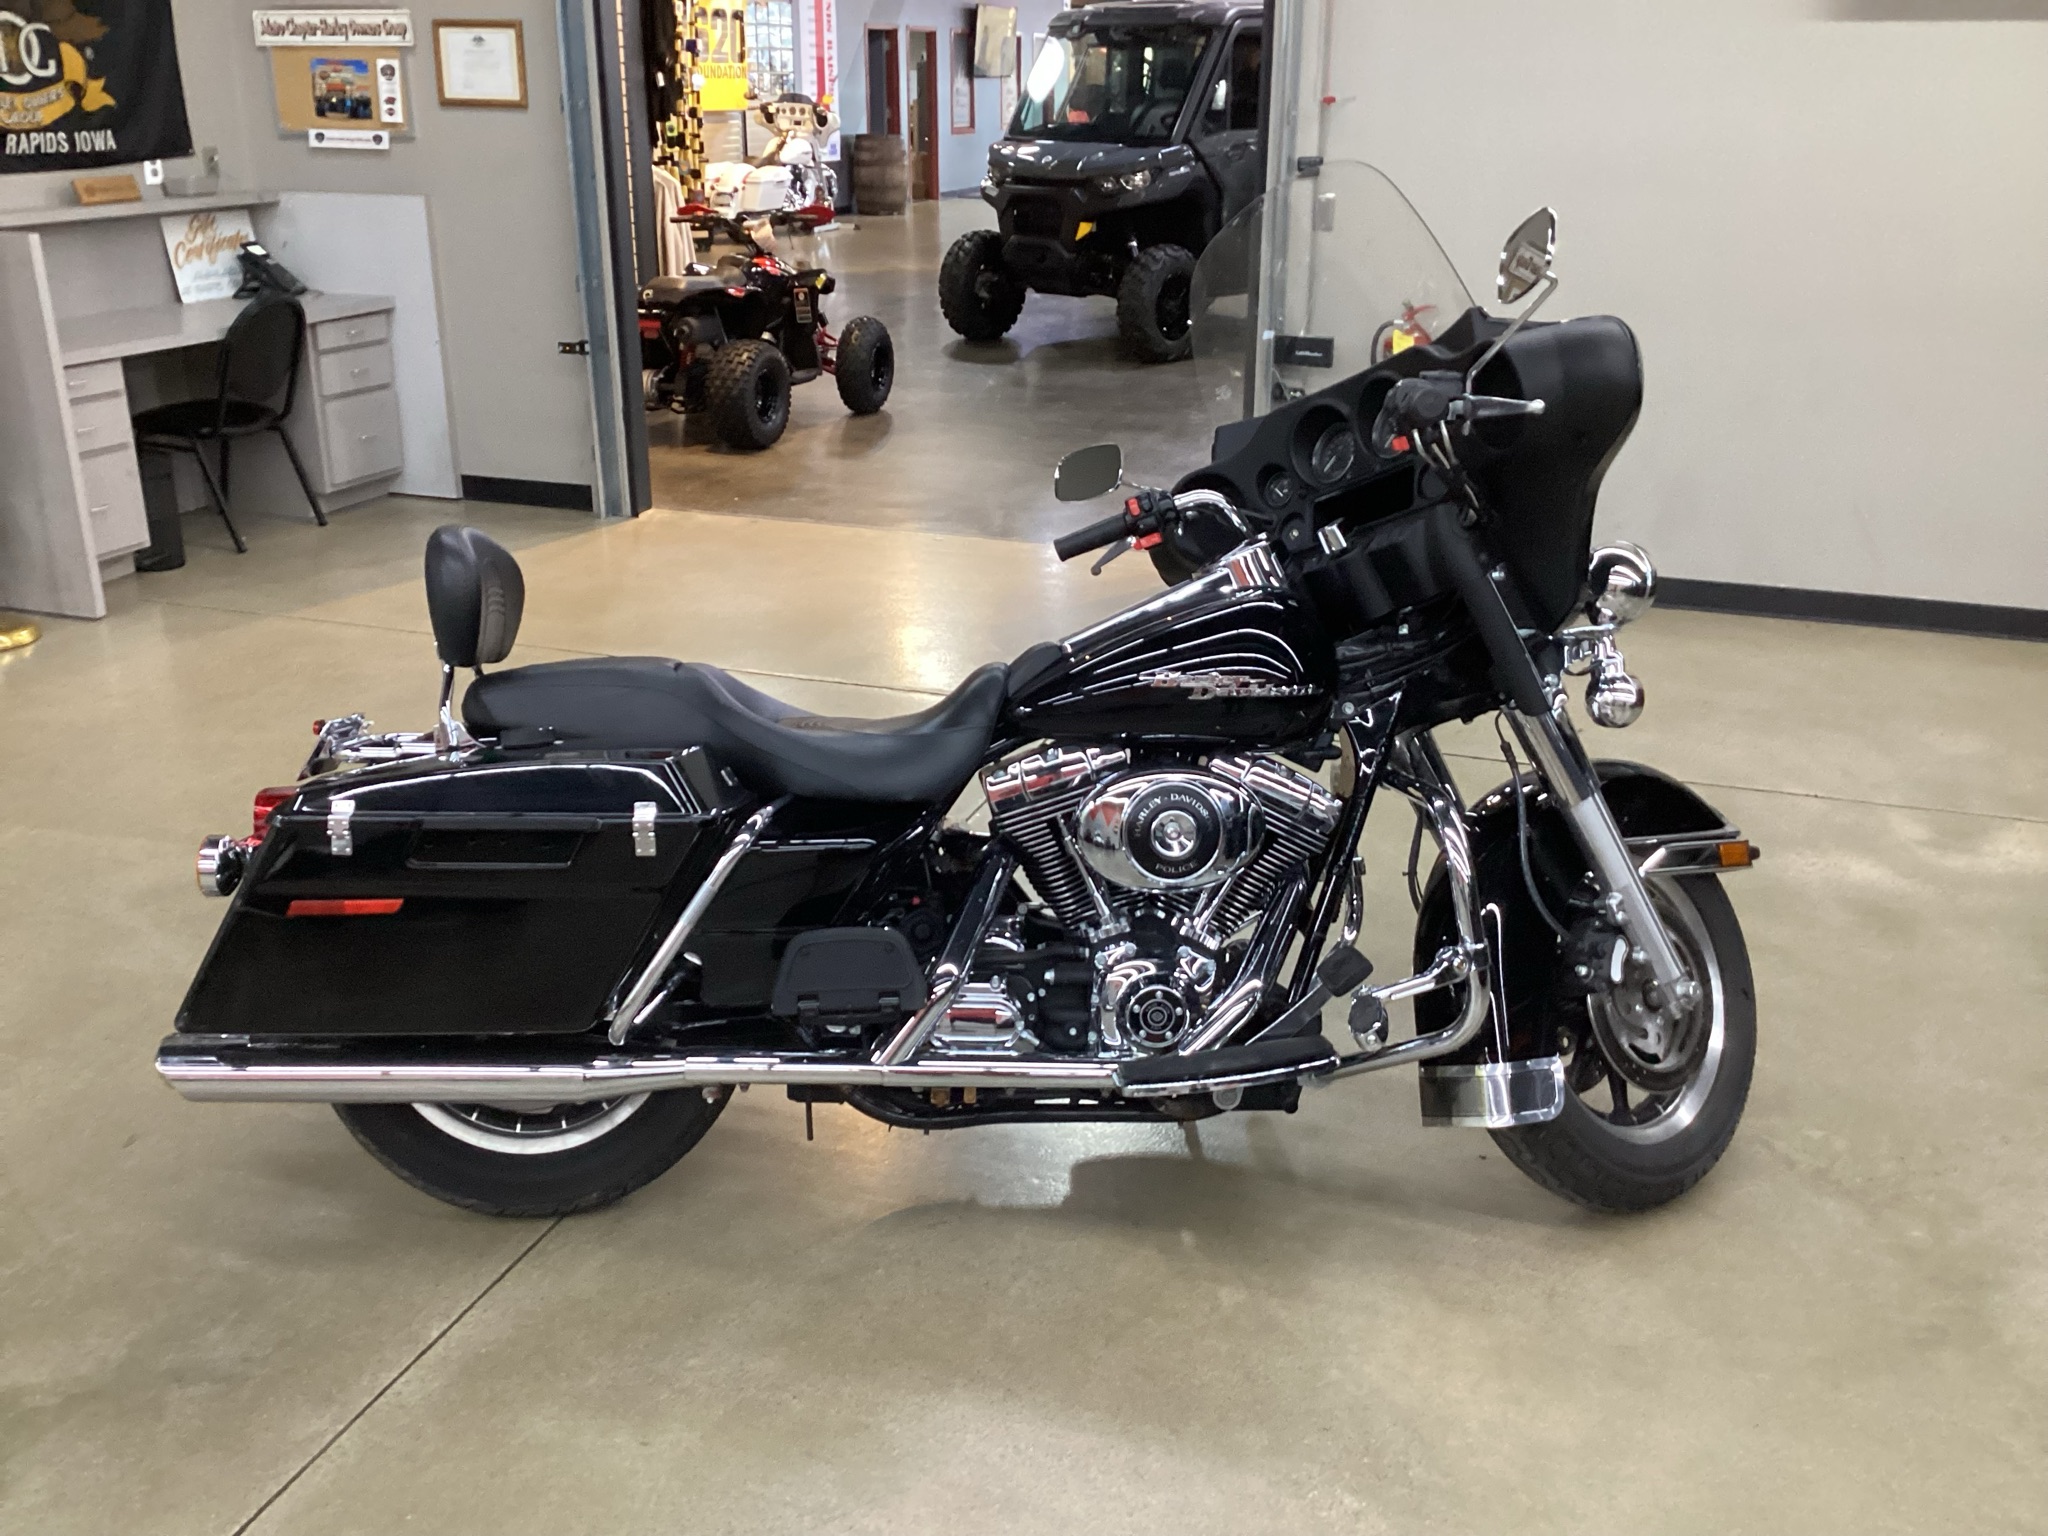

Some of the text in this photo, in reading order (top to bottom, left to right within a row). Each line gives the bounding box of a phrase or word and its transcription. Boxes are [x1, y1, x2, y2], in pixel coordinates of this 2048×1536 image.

[698, 66, 747, 79] OUNDATION
[5, 129, 117, 155] RAPIDS IOWA
[1155, 860, 1199, 874] POLICE
